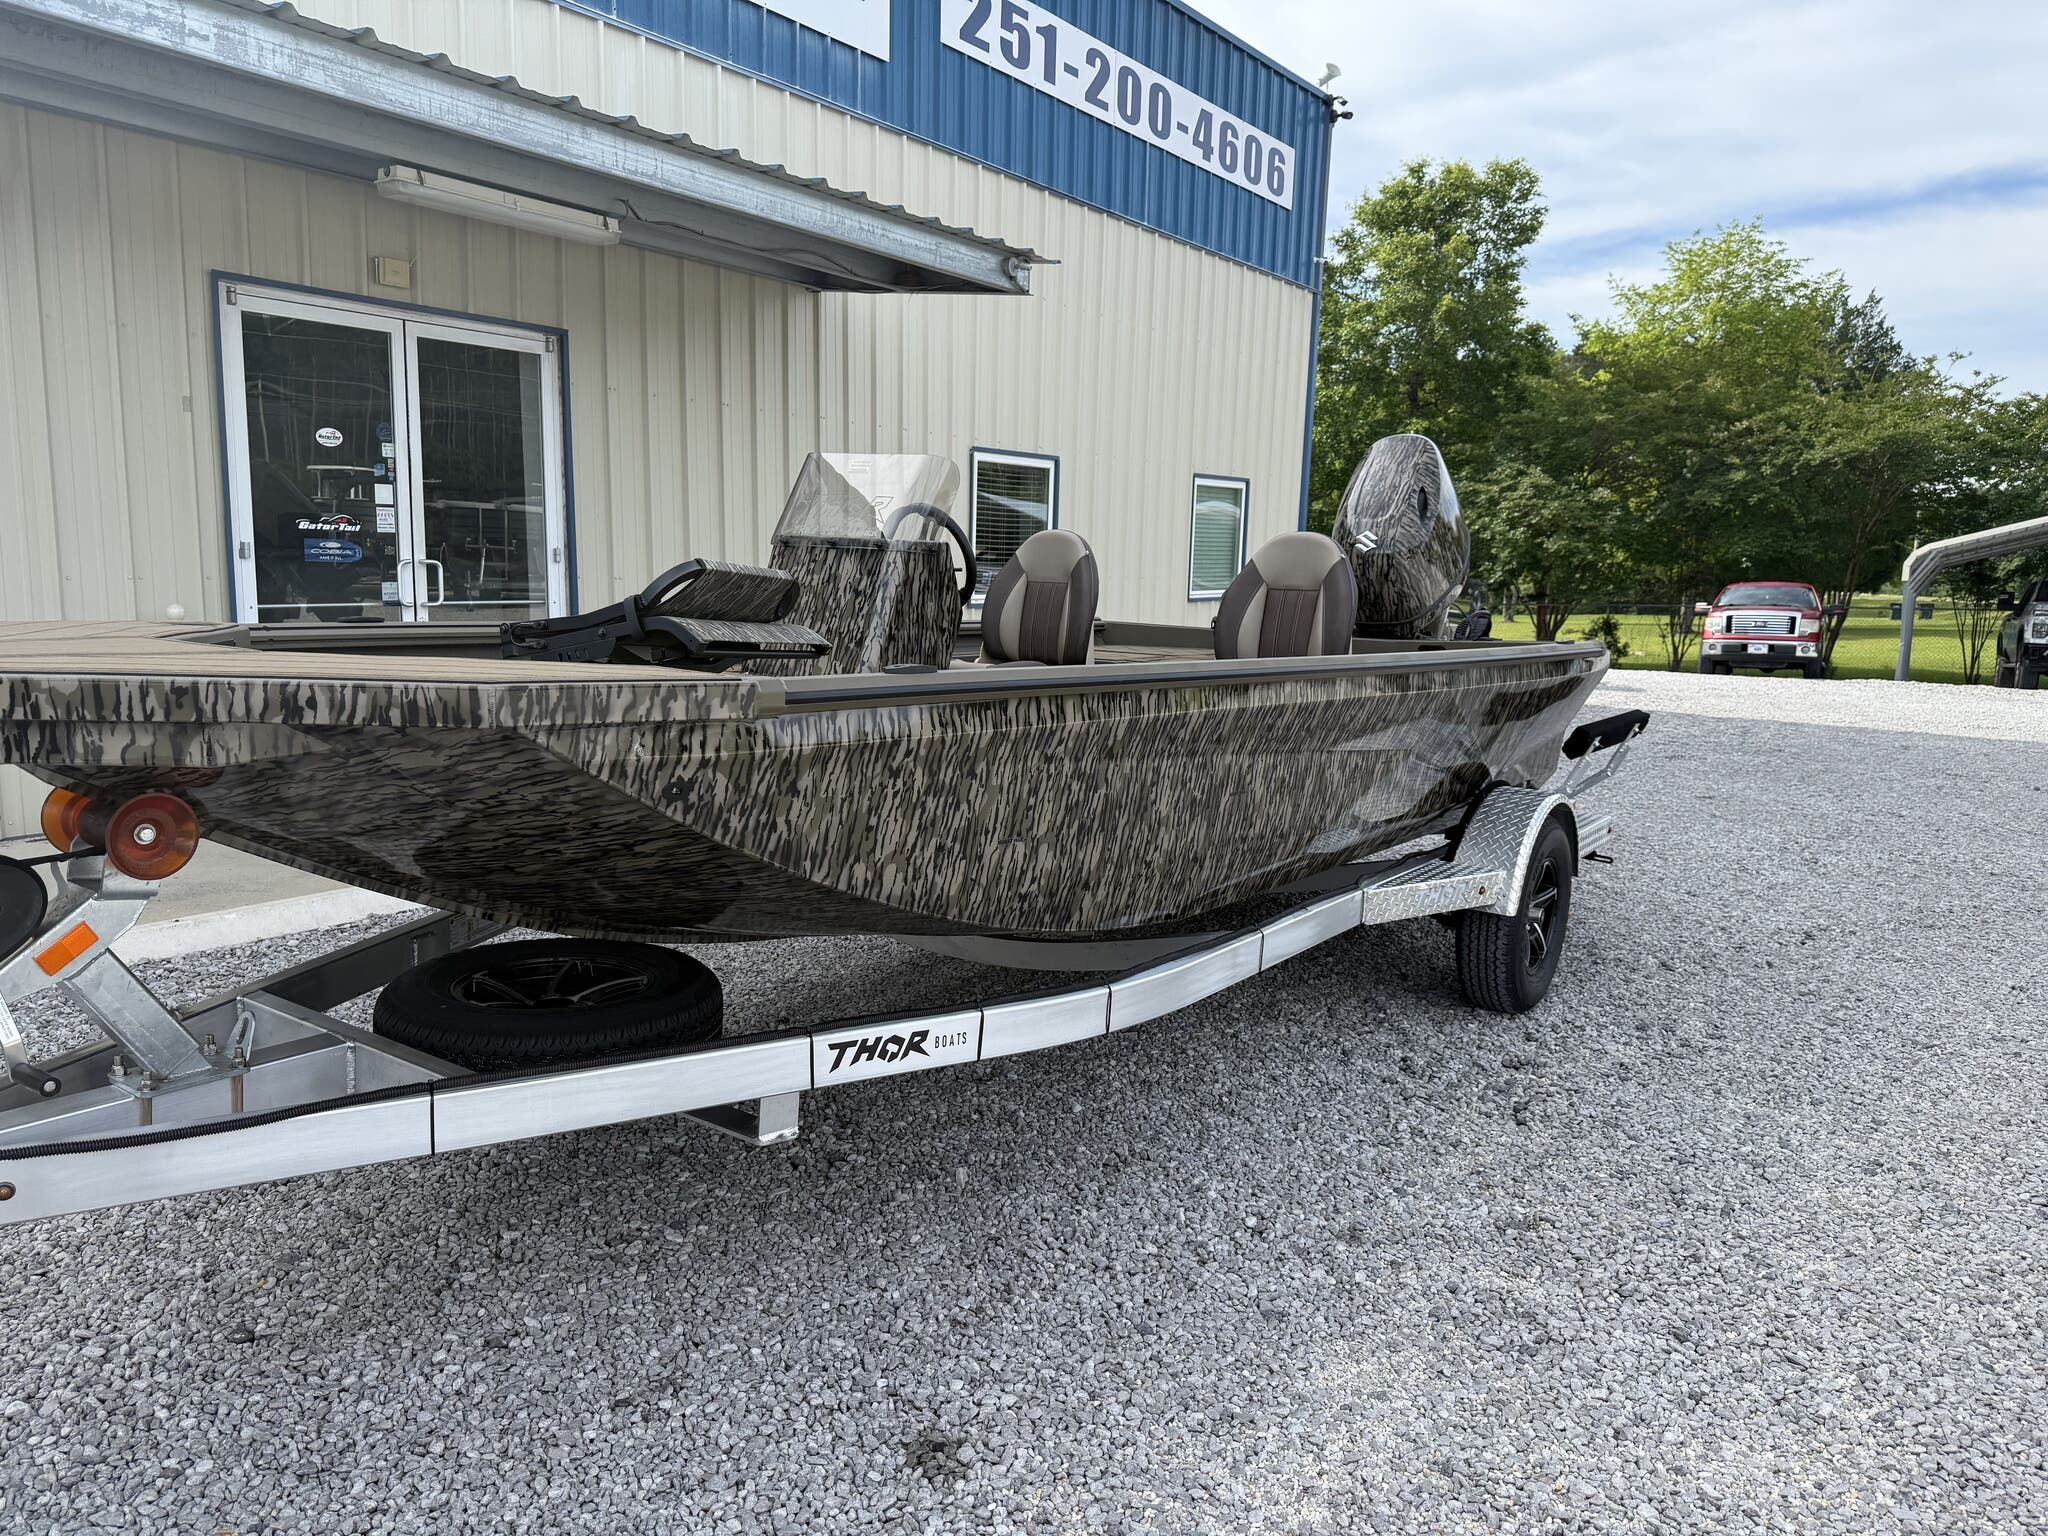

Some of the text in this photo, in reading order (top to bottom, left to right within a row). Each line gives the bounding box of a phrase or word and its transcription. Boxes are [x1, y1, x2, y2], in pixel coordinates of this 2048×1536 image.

[958, 0, 1286, 197] 251-200-4606
[828, 1029, 967, 1074] THOR BOATS
